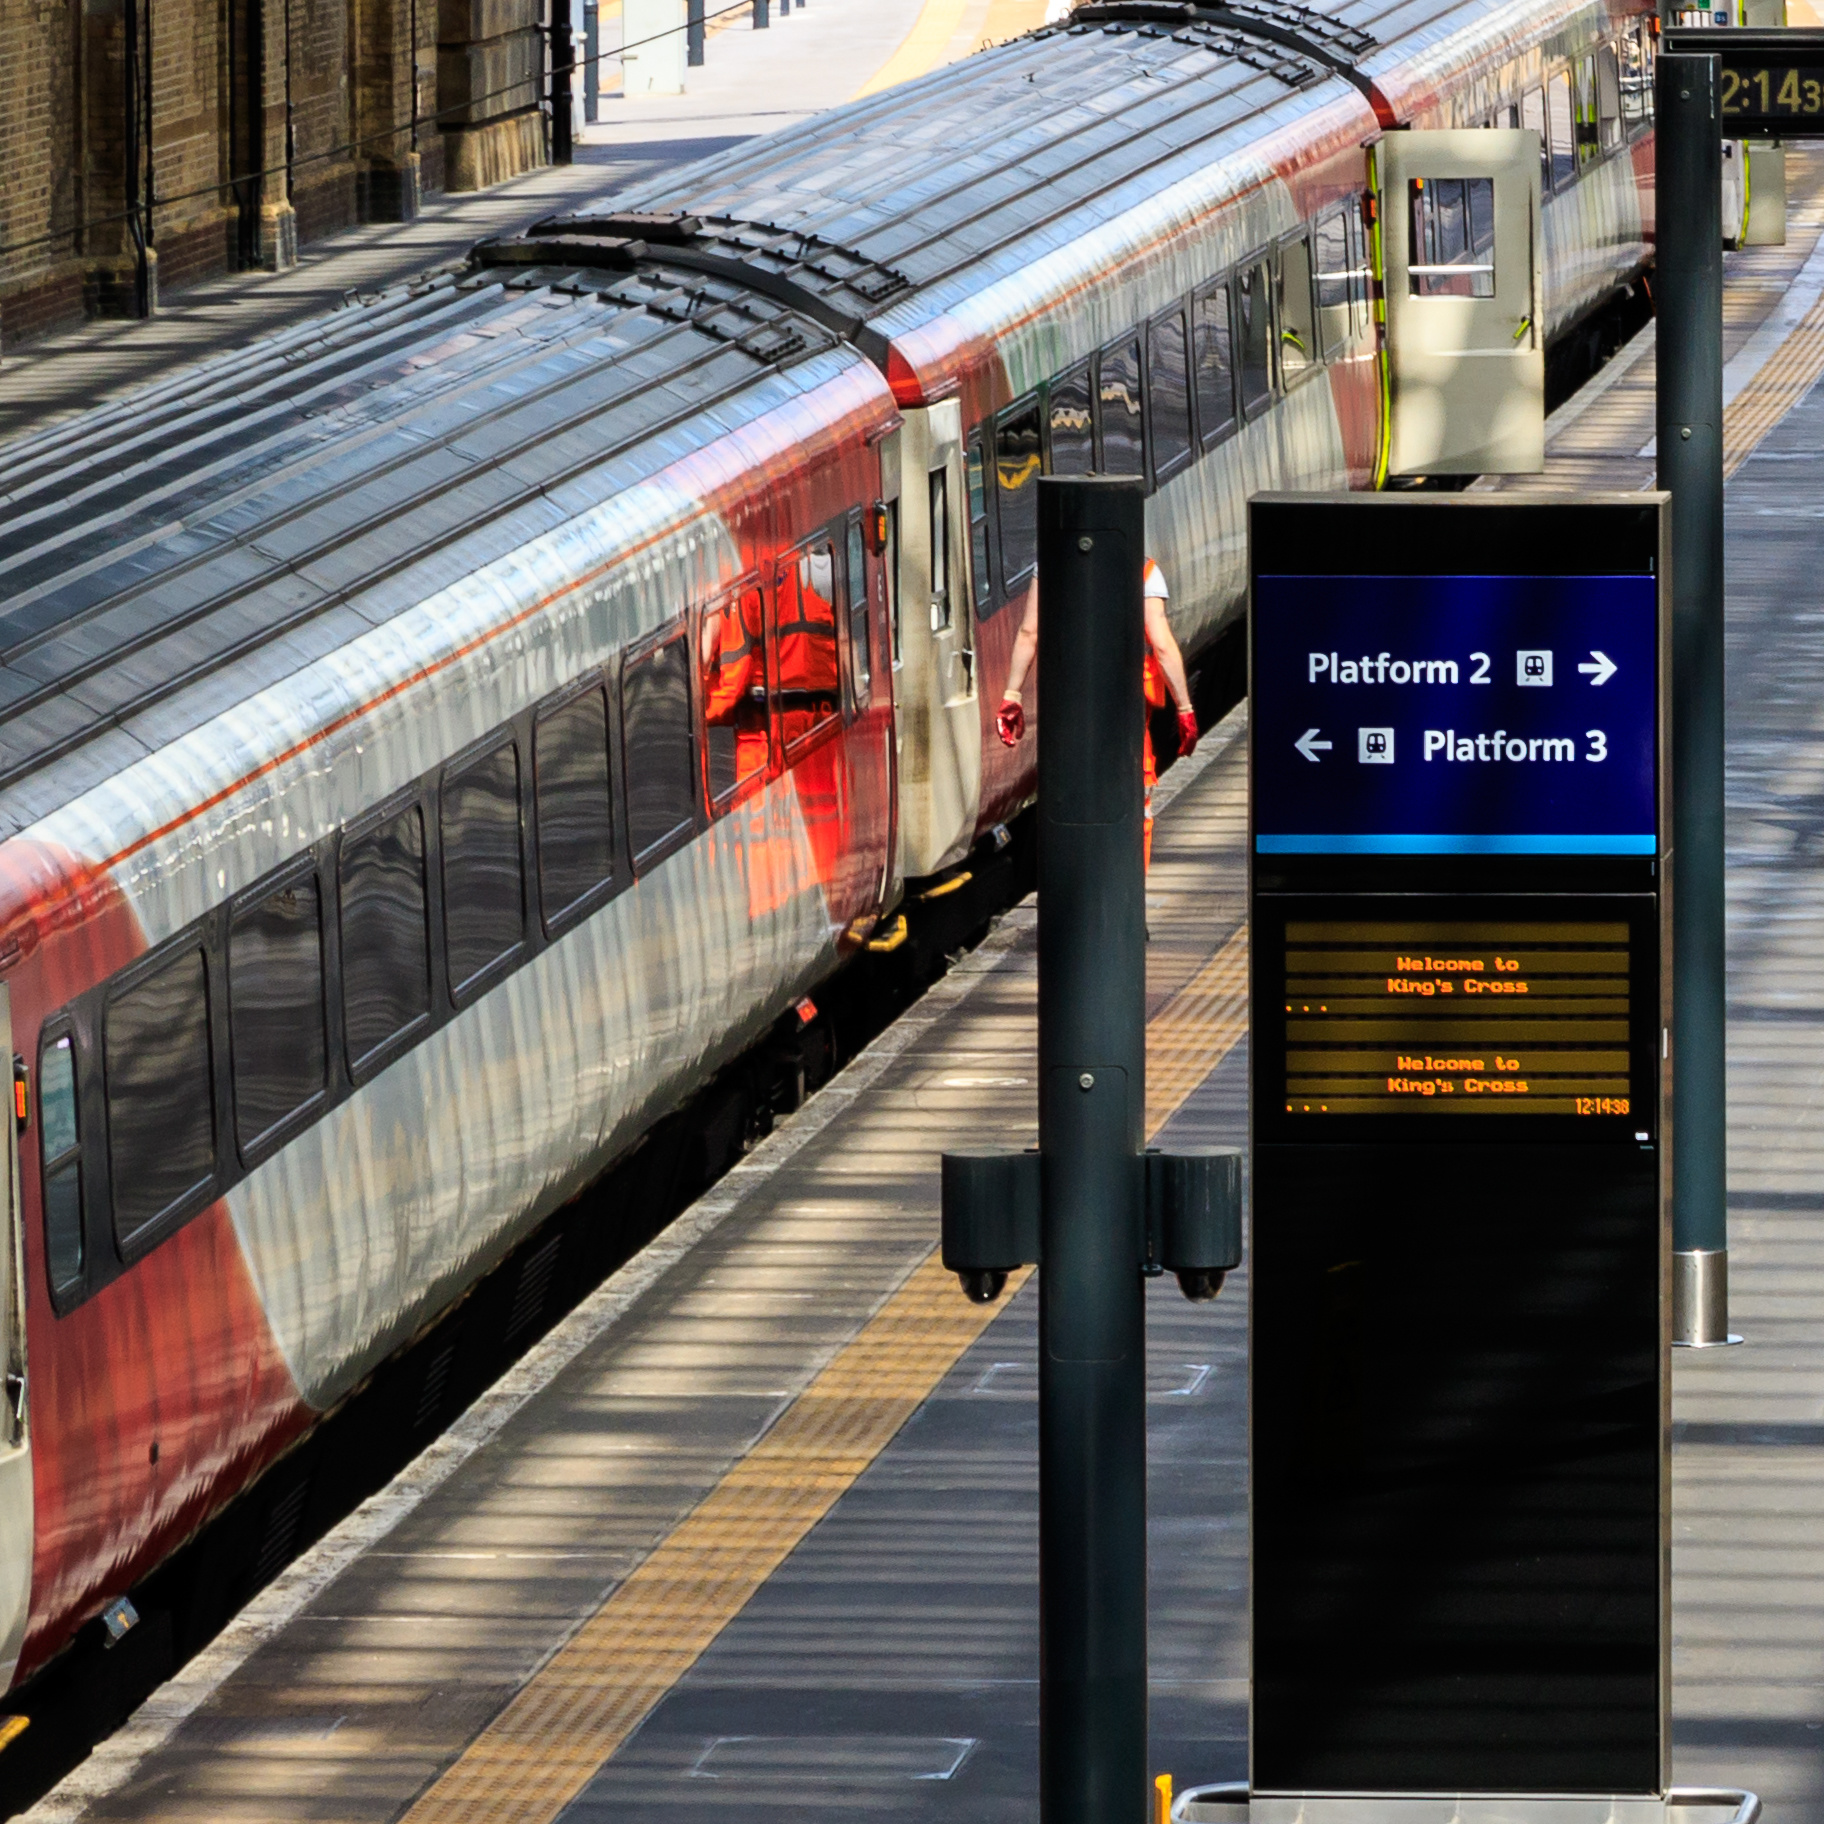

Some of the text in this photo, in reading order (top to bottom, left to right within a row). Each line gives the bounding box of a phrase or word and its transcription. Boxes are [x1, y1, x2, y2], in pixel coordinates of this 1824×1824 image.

[1721, 69, 1801, 114] 2:14
[1308, 651, 1491, 684] Platform 2
[1423, 729, 1608, 762] Platform 3
[1396, 956, 1519, 971] Welcome to
[1387, 978, 1528, 995] King's Cross
[1396, 1056, 1520, 1071] Welcome to
[1387, 1077, 1528, 1095] King's Cross
[1575, 1097, 1630, 1115] 12:14:38
